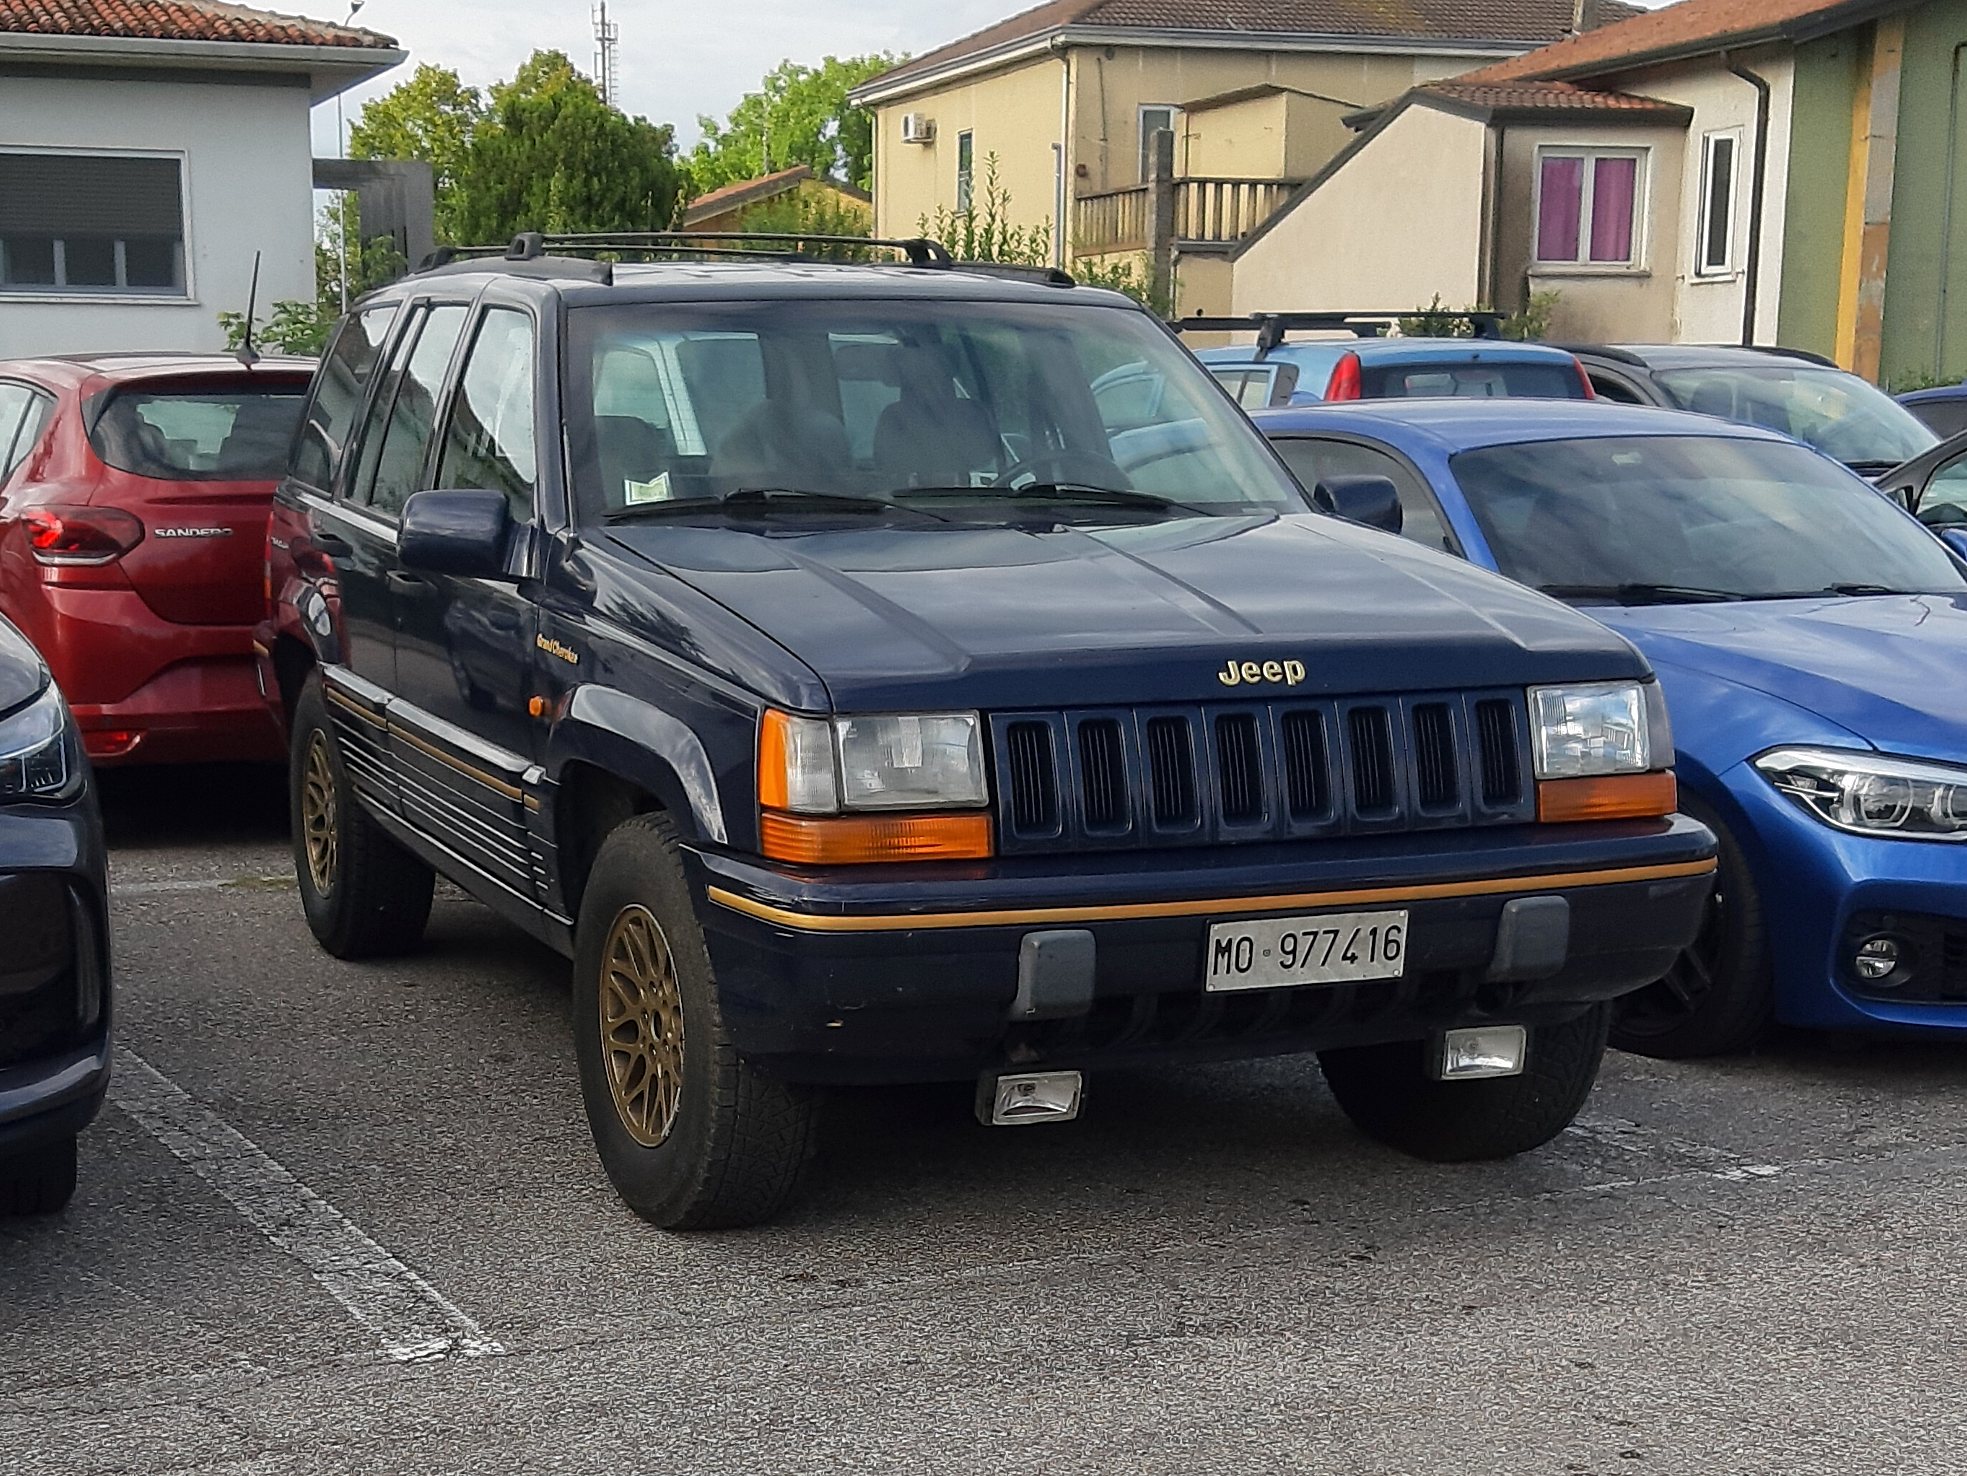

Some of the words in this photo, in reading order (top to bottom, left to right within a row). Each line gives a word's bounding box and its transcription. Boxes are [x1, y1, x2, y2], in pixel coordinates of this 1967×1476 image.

[154, 528, 234, 537] SANDERO
[1218, 660, 1306, 686] Jeep
[1212, 936, 1253, 976] MO
[1278, 925, 1402, 969] 977416
